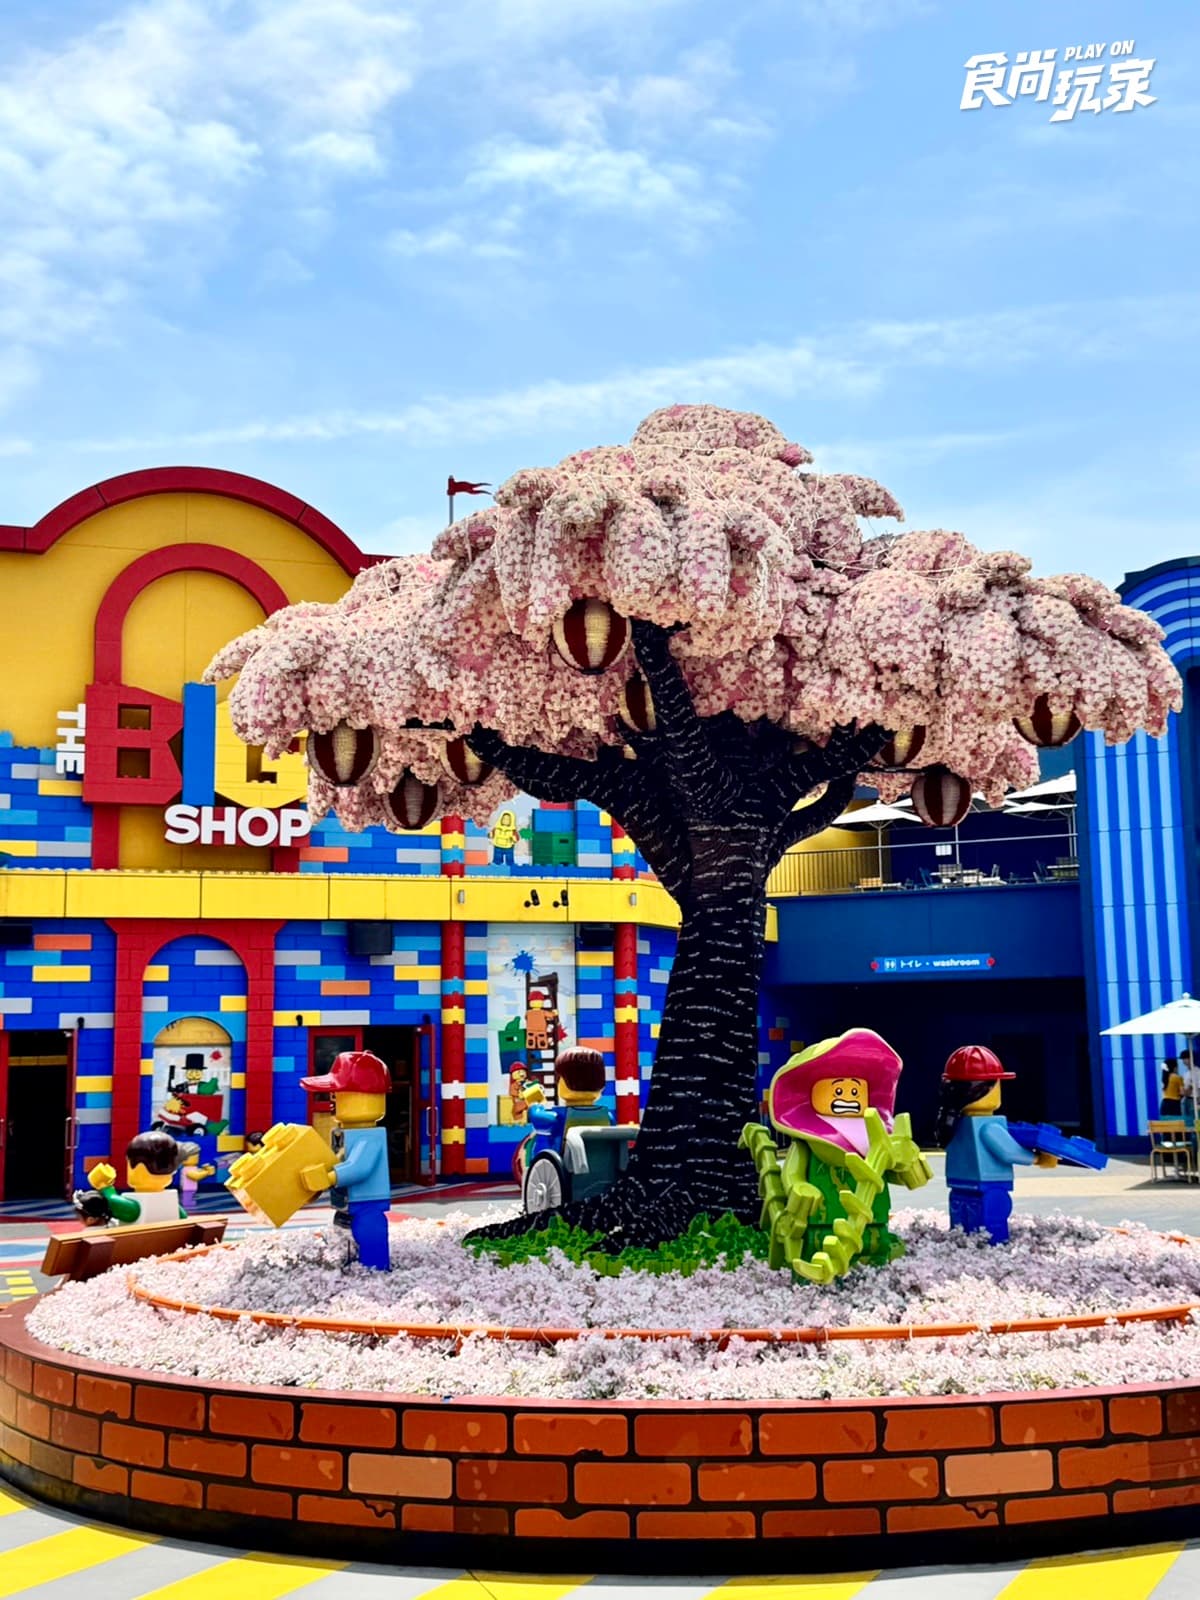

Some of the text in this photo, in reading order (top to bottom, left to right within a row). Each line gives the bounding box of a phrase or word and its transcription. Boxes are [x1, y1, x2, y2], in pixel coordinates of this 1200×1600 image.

[56, 703, 86, 774] THE
[82, 682, 310, 808] BIG
[164, 804, 312, 847] SHOP
